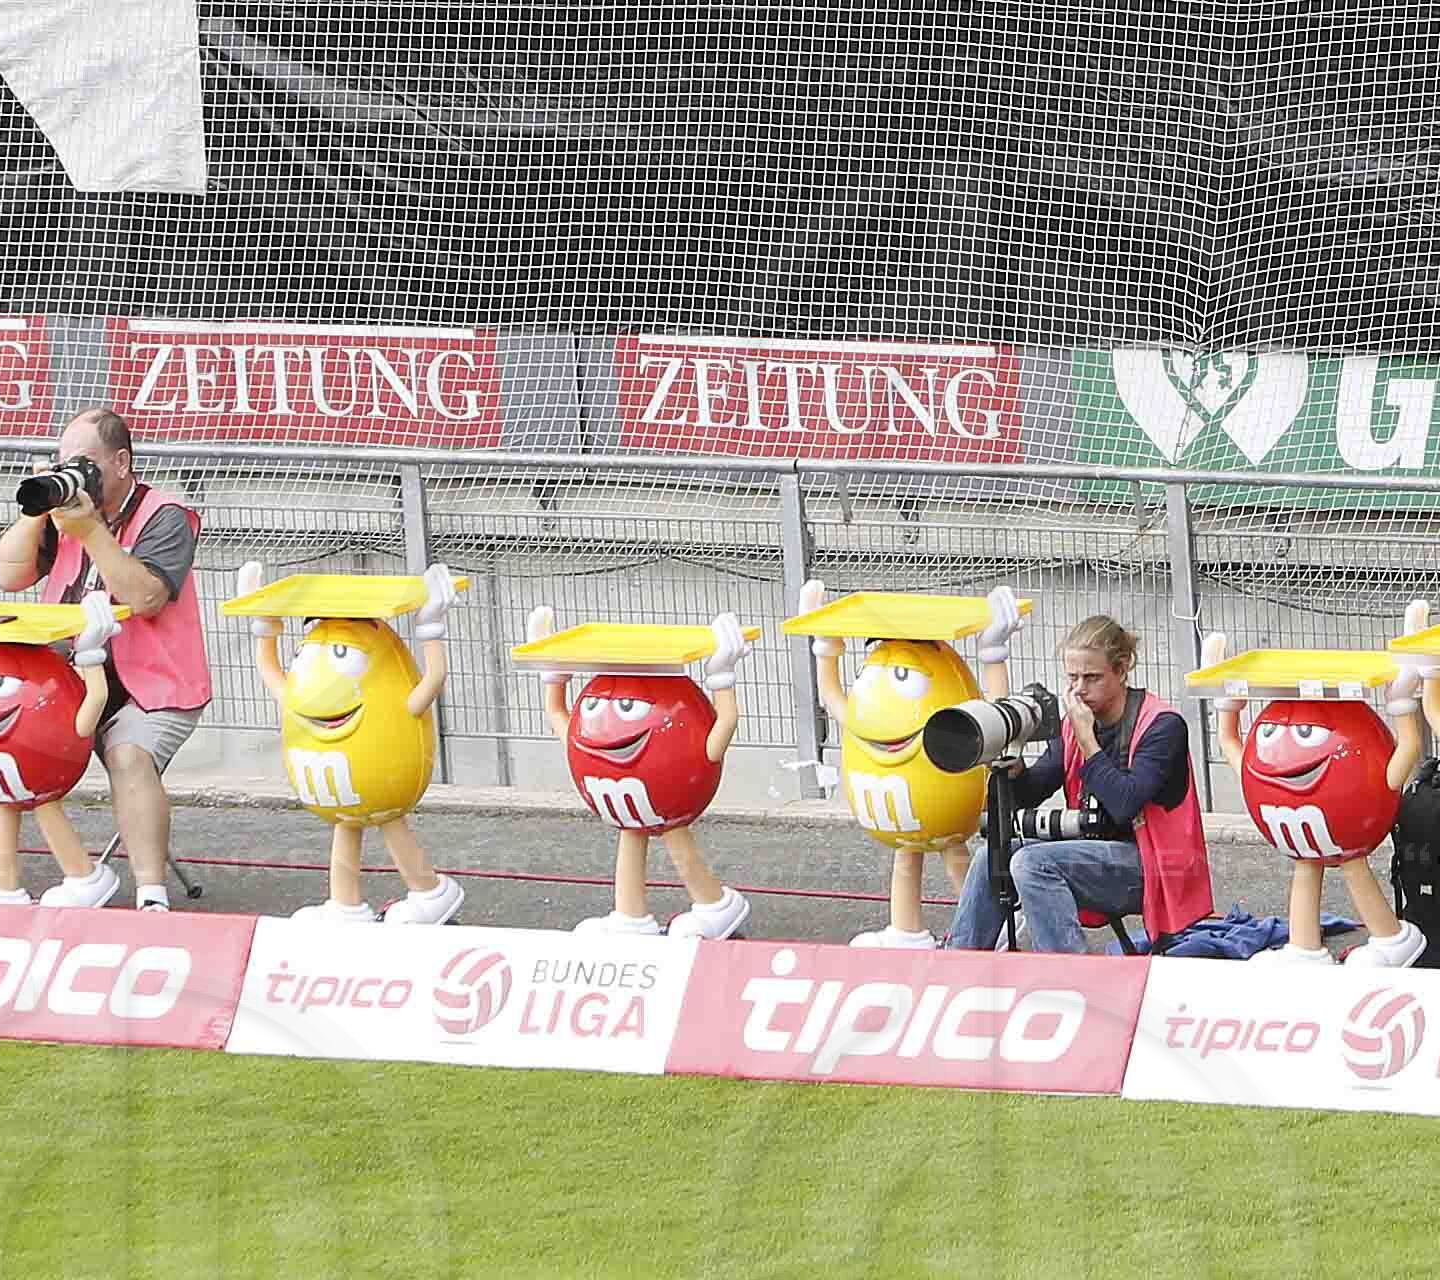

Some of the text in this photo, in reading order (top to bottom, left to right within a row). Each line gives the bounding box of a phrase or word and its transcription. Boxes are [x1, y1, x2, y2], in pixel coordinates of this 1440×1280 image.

[129, 342, 485, 421] ZEITUNG
[640, 354, 1004, 439] ZEITUNG
[288, 749, 360, 807] m
[584, 776, 663, 828] m
[848, 772, 921, 832] m
[1260, 803, 1342, 857] m
[265, 962, 413, 1013] tipico
[532, 959, 657, 991] BUNDES
[518, 992, 647, 1040] LIGA
[741, 949, 1087, 1076] tipico
[1165, 1005, 1320, 1058] tipico
